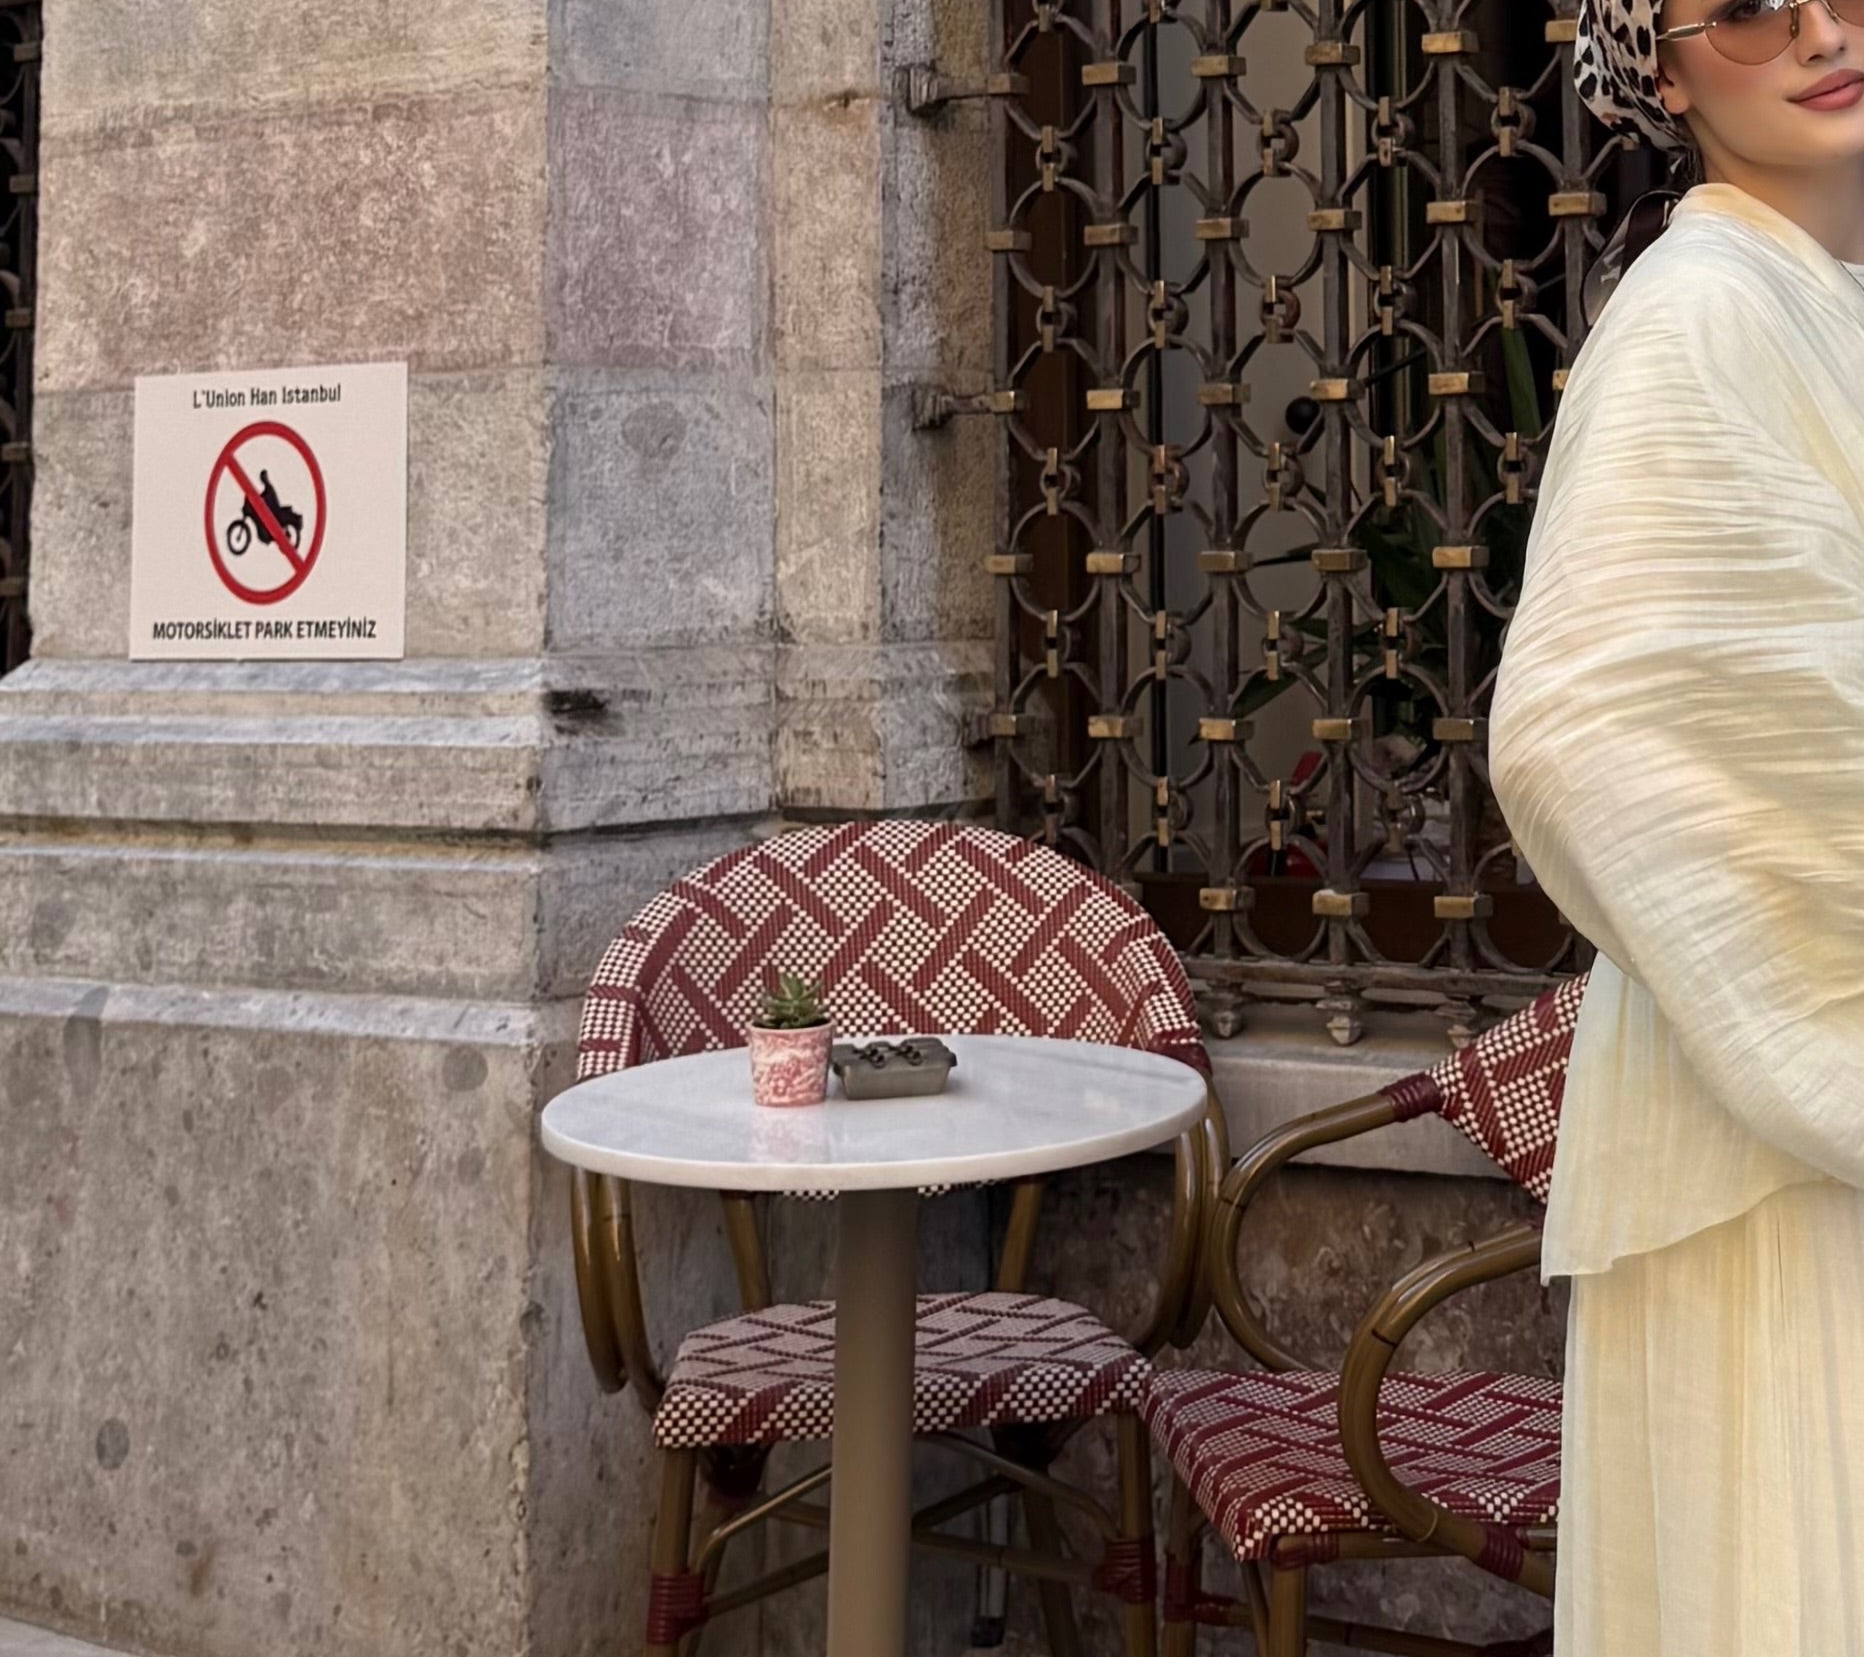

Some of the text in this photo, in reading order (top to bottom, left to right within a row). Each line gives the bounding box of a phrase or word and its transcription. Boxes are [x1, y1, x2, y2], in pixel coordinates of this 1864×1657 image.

[250, 387, 277, 406] Han
[282, 383, 341, 404] Istanbul
[153, 616, 376, 640] MOTORSİKLET PARK ETMEYİNİZ
